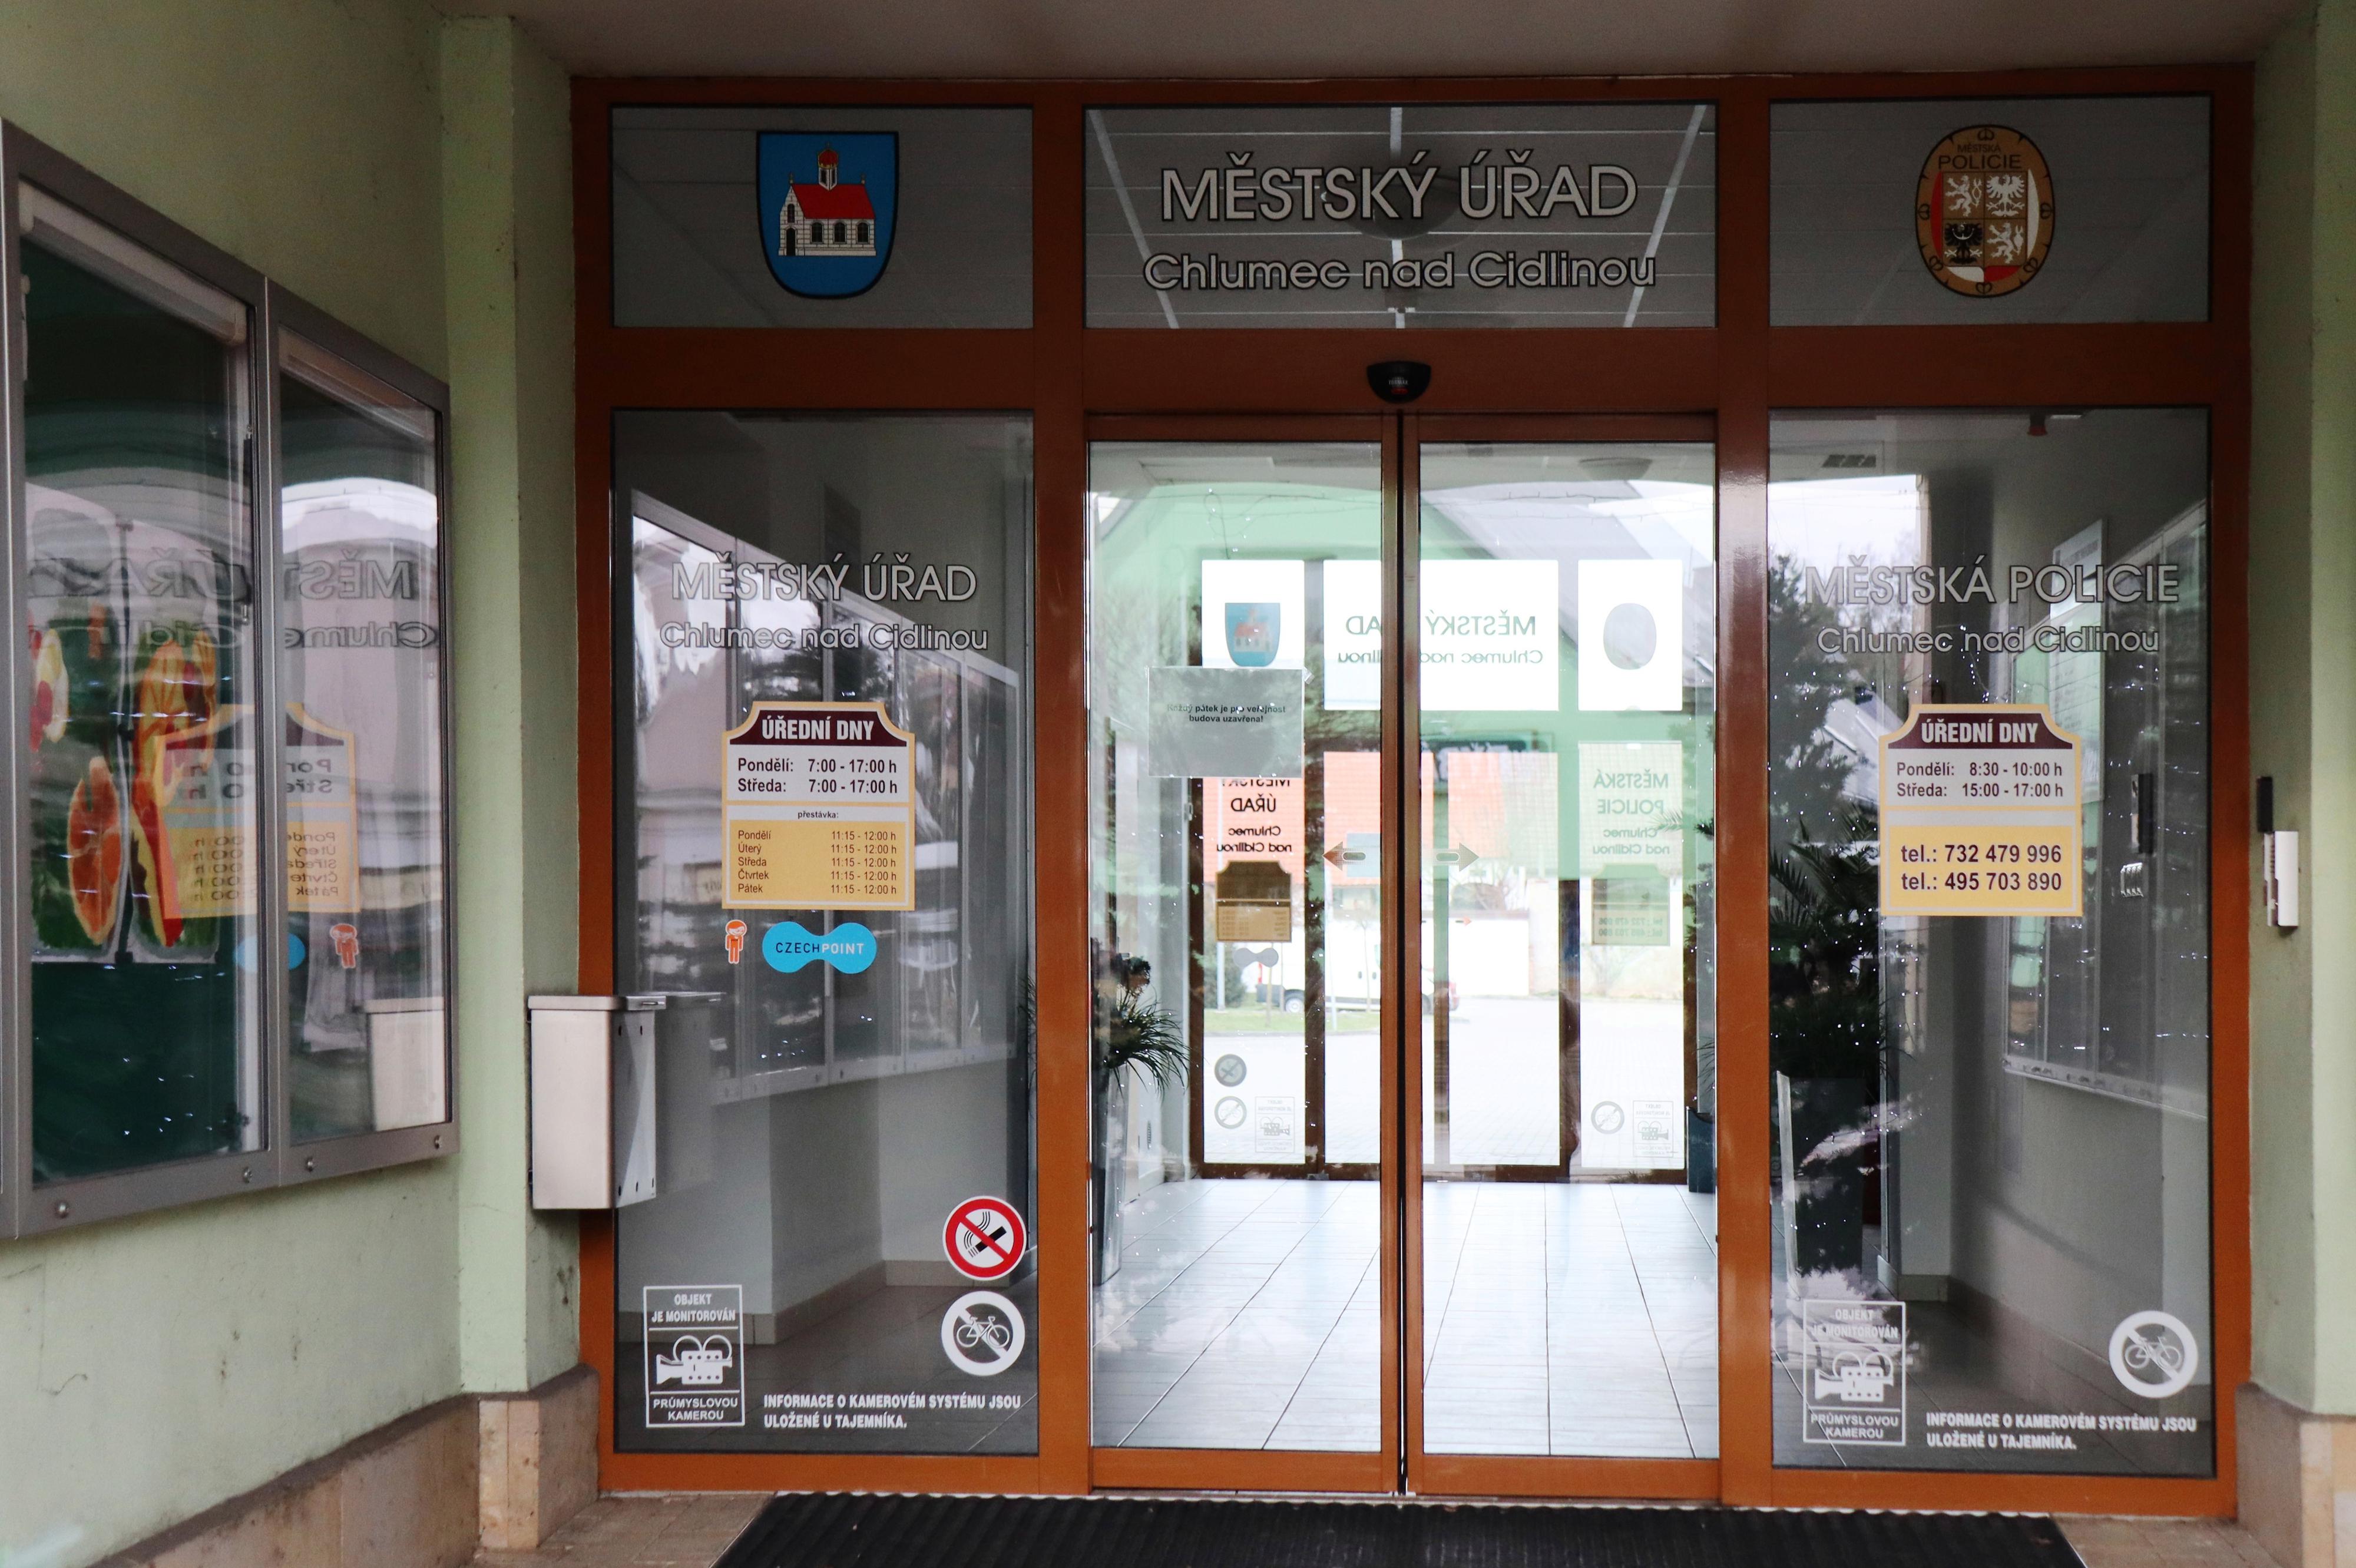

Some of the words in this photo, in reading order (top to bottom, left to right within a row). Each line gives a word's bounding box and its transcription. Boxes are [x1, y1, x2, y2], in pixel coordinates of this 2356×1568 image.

[1957, 143, 2001, 153] MĚSTSKÁ
[1938, 154, 2022, 170] POLICIE
[1162, 151, 1439, 221] MĚSTSKÝ
[1458, 148, 1638, 220] ÚŘAD
[1144, 253, 1349, 291] Chlumec
[1362, 254, 1454, 289] nad
[1469, 252, 1656, 288] Cidlinou
[672, 552, 850, 601] MĚSTSKÝ
[863, 553, 977, 601] ÚŘAD
[1806, 554, 1997, 604] MĚSTSKÁ
[2010, 564, 2179, 603] POLICIE
[660, 622, 795, 648] Chlumec
[802, 623, 860, 649] nad
[868, 624, 988, 650] Cidlinou
[1818, 627, 1953, 653] Chlumec
[1964, 627, 2025, 652] nad
[2034, 626, 2159, 651] Cidlinou
[1220, 705, 1228, 713] je
[762, 715, 832, 740] ÚŘEDNÍ
[837, 720, 874, 740] DNY
[1922, 719, 1994, 743] ÚŘEDNÍ
[2000, 723, 2038, 743] DNY
[738, 757, 793, 772] Pondělí:
[808, 759, 836, 772] 7:00
[849, 759, 884, 773] 17:00
[889, 760, 896, 773] h
[1897, 762, 1954, 776] Pondělí:
[1970, 763, 1998, 776] 8:30
[2013, 763, 2049, 776] 10:00
[2054, 763, 2062, 776] h
[738, 778, 786, 792] Středa:
[809, 779, 836, 792] 7:00
[850, 780, 885, 793] 17:00
[889, 780, 897, 793] h
[1897, 783, 1947, 796] Středa:
[1962, 783, 1999, 796] 15:00
[2014, 783, 2050, 796] 17:00
[2056, 783, 2063, 796] h
[798, 811, 839, 819] přestávka:
[738, 830, 772, 839] Pondělí
[832, 831, 855, 840] 11:15
[864, 832, 888, 841] 12:00
[891, 832, 896, 841] h
[738, 842, 762, 855] Úterý
[830, 845, 855, 854] 11:15
[864, 845, 888, 854] 12:00
[891, 845, 896, 854] h
[1901, 845, 1937, 862] tel.:
[1945, 845, 1978, 862] 732
[1986, 845, 2020, 862] 479
[2027, 845, 2062, 862] 996
[738, 857, 767, 866] Středa
[832, 858, 855, 866] 11:15
[864, 858, 888, 867] 12:00
[891, 858, 896, 867] h
[738, 869, 769, 879] Čtvrtek
[830, 871, 855, 880] 11:15
[864, 871, 888, 881] 12:00
[891, 871, 896, 881] h
[1901, 872, 1937, 890] tel.:
[1945, 872, 1979, 890] 495
[1987, 872, 2020, 890] 703
[2028, 872, 2062, 890] 890
[738, 884, 763, 893] Pátek
[830, 885, 855, 894] 11:15
[864, 885, 888, 894] 12:00
[891, 885, 896, 894] h
[674, 1294, 712, 1306] OBJEKT
[651, 1311, 663, 1323] JE
[666, 1308, 736, 1323] MONITOROVÁN
[1835, 1308, 1874, 1321] OBJEKT
[1826, 1324, 1898, 1339] MONITOROVÁN
[653, 1395, 739, 1409] PRŮMYSLOVOU
[764, 1394, 834, 1409] INFORMACE
[837, 1395, 846, 1409] O
[849, 1392, 925, 1409] KAMEROVÉM
[928, 1392, 985, 1410] SYSTÉMU
[988, 1395, 1021, 1410] JSOU
[668, 1410, 724, 1421] KAMEROU
[764, 1412, 820, 1429] ULOŽENÉ
[823, 1415, 832, 1429] U
[835, 1412, 908, 1429] TAJEMNÍKA.
[1811, 1413, 1898, 1427] PRŮMYSLOVOU
[1927, 1412, 2000, 1428] INFORMACE
[2003, 1414, 2013, 1428] O
[2016, 1412, 2095, 1430] KAMEROVÉM
[2099, 1412, 2158, 1430] SYSTÉMU
[2162, 1417, 2196, 1432] JSOU
[1825, 1427, 1884, 1439] KAMEROU
[1927, 1430, 1986, 1448] ULOŽENÉ
[1988, 1433, 1998, 1448] U
[2000, 1433, 2077, 1450] TAJEMNÍKA.
